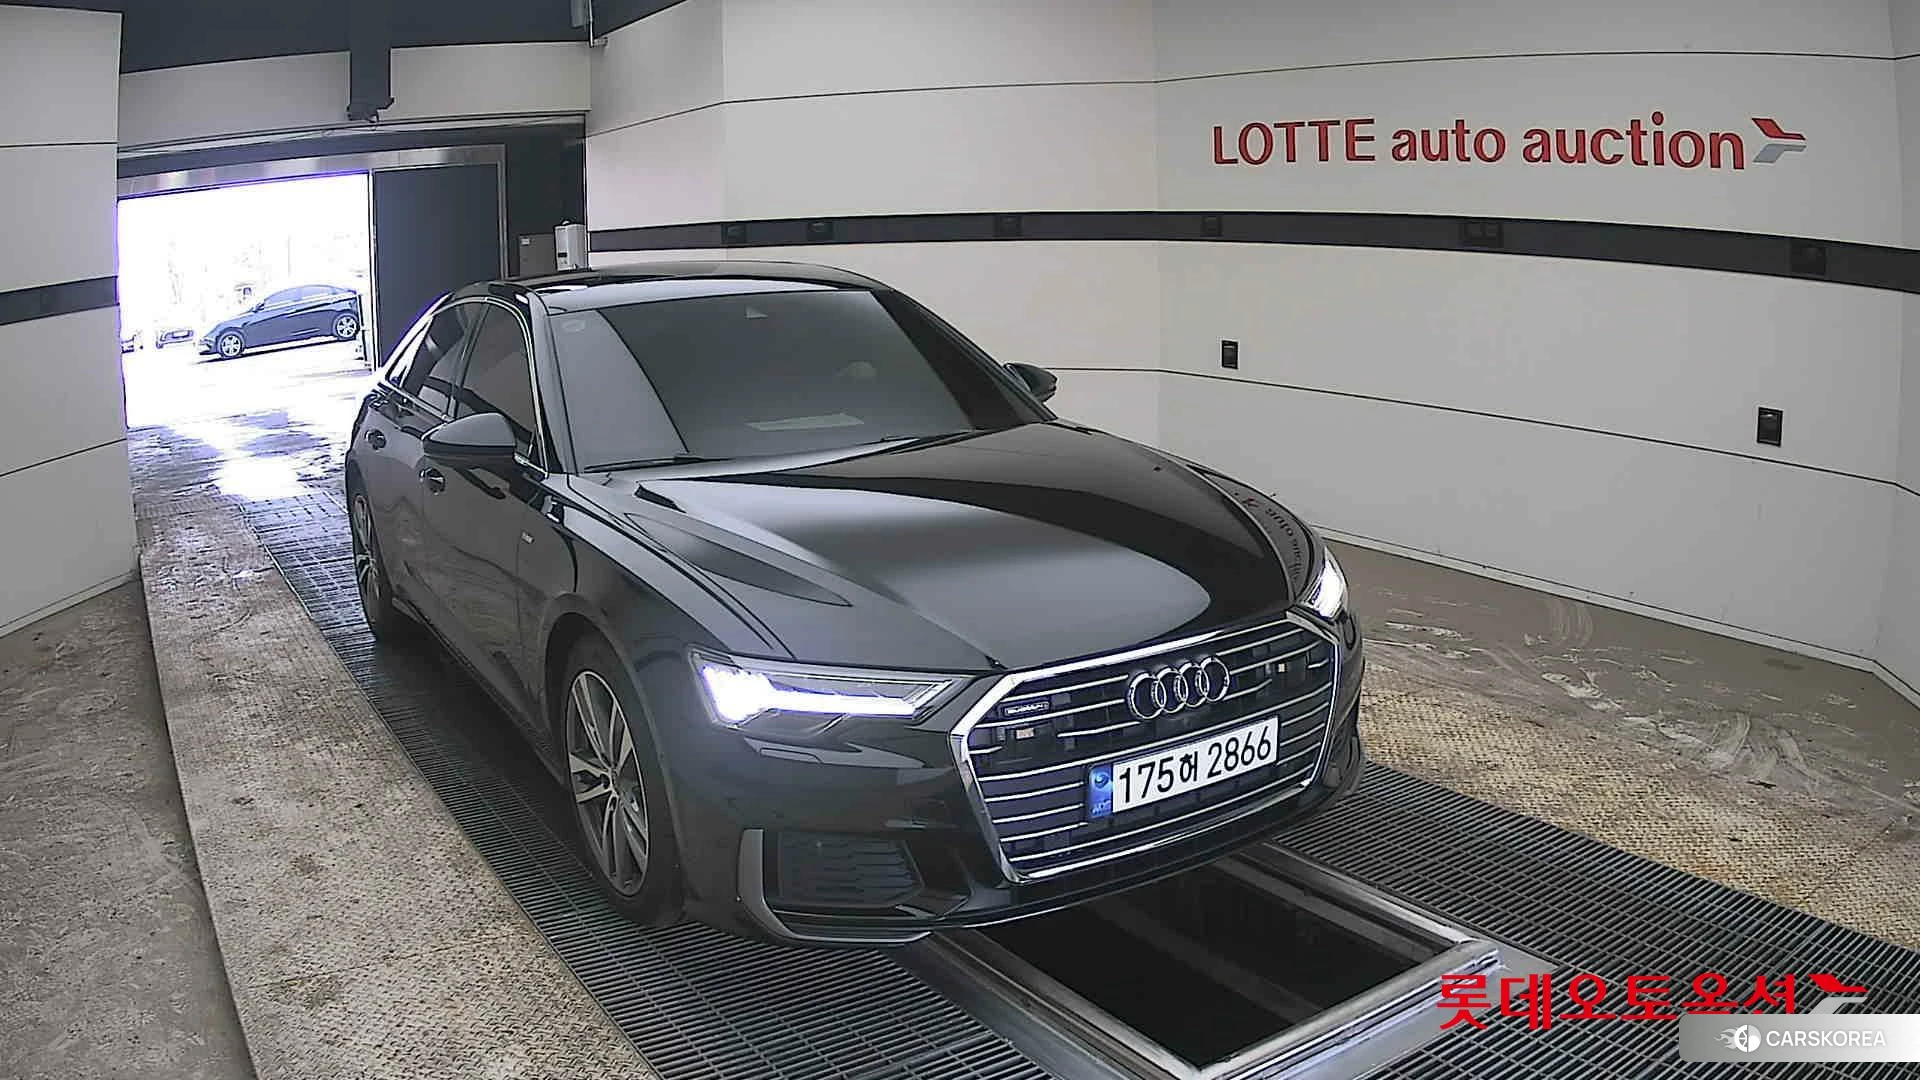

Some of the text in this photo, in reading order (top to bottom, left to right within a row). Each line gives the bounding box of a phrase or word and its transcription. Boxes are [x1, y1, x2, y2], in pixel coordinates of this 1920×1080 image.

[1213, 111, 1745, 170] LOTTE auto auction
[1207, 725, 1272, 779] 2866
